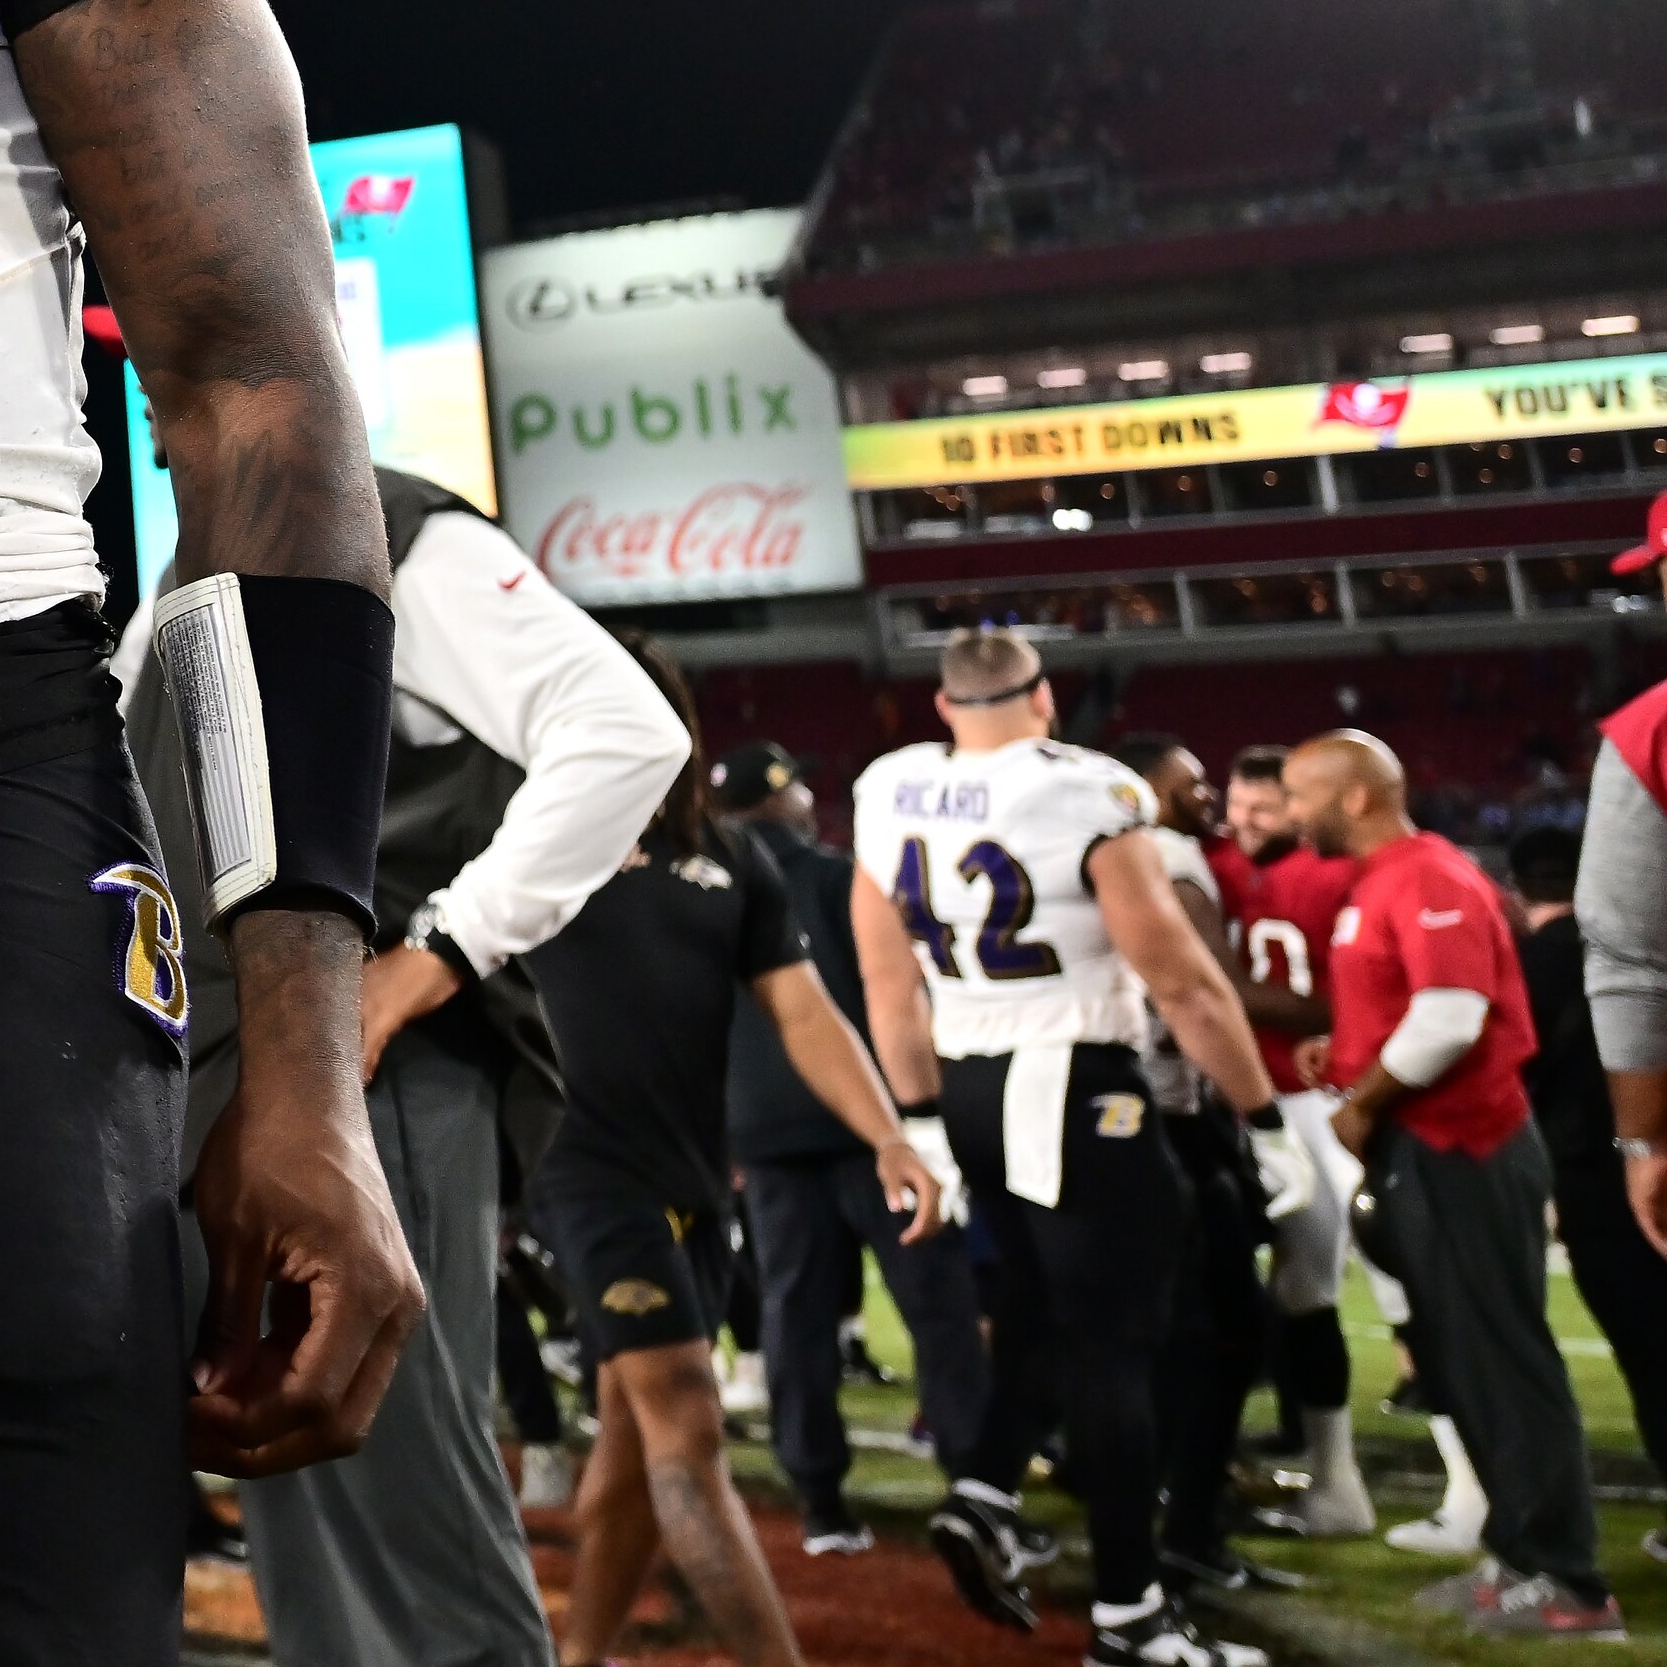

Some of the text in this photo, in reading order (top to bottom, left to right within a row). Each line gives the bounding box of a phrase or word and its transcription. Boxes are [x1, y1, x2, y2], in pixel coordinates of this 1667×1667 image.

[584, 266, 777, 315] LEXU
[509, 370, 797, 455] Publix
[1484, 374, 1635, 418] YOU'VE
[940, 411, 1239, 463] 10 FIRST DOWNS
[894, 781, 989, 822] RICARD
[892, 834, 1063, 981] 42
